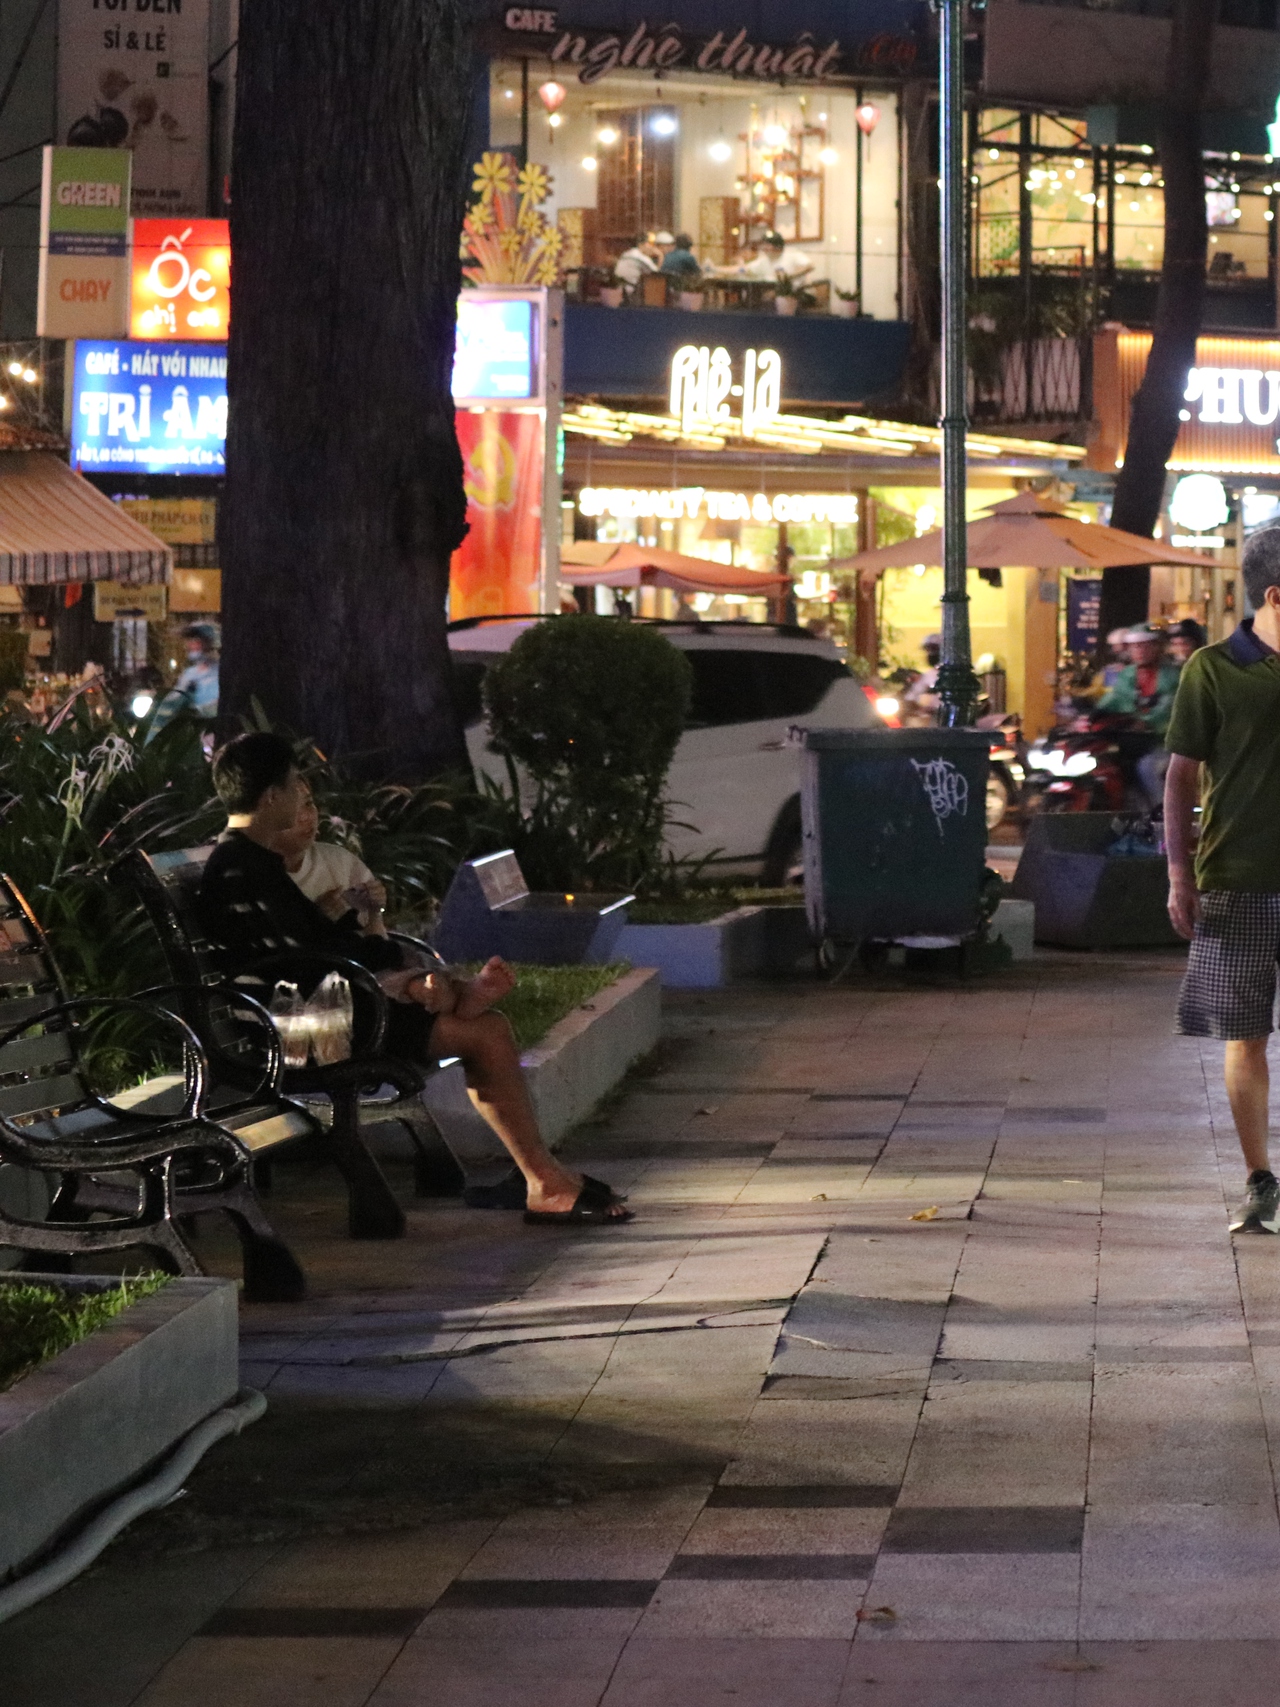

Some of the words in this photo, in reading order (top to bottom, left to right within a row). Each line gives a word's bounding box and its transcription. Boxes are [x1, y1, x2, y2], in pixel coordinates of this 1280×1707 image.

[505, 7, 558, 33] CAFE
[126, 30, 140, 50] &
[56, 181, 122, 207] GREEN
[149, 226, 217, 302] Ốc
[85, 348, 120, 375] CAFÉ
[751, 493, 773, 521] &
[772, 493, 859, 523] COFFEE
